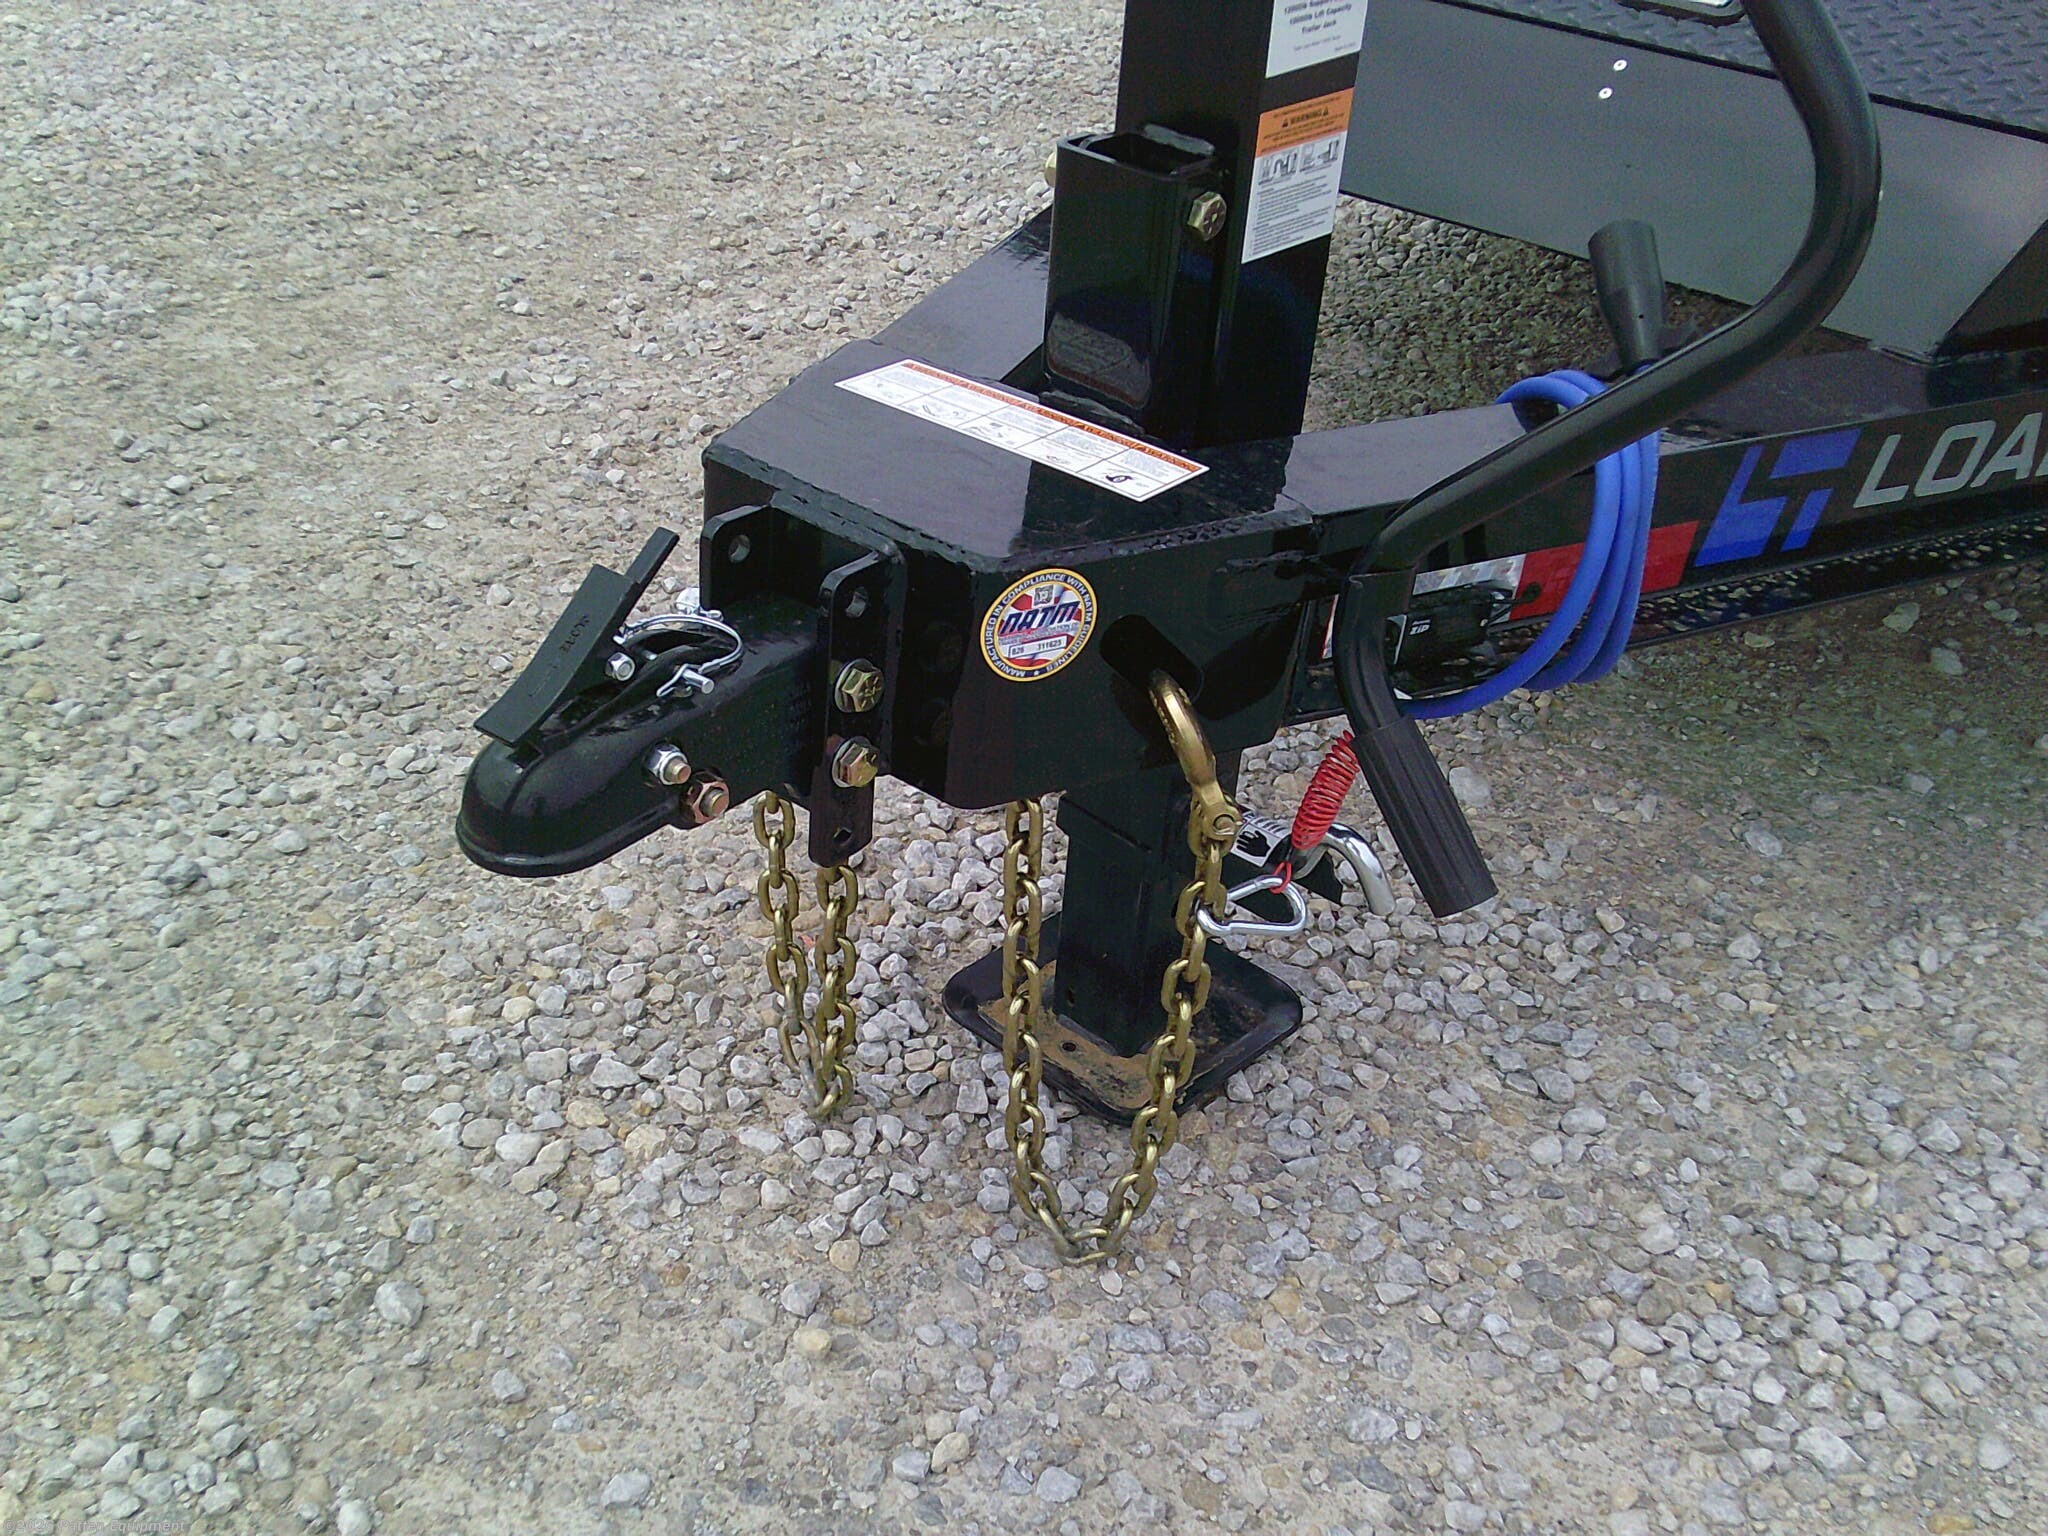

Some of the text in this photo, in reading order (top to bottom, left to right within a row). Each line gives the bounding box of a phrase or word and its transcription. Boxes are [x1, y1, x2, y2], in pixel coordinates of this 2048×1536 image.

[1314, 9, 1325, 18] Lift
[1326, 3, 1352, 16] Capacity
[1323, 19, 1337, 29] Jack
[1853, 412, 2048, 509] LOA
[1001, 573, 1065, 605] COMPLIANCE
[1066, 575, 1088, 594] WITH
[1000, 600, 1081, 636] NATM
[1082, 593, 1093, 623] NATM
[984, 616, 1026, 678] MANUFACTURED
[1045, 624, 1091, 673] GUIDELINES
